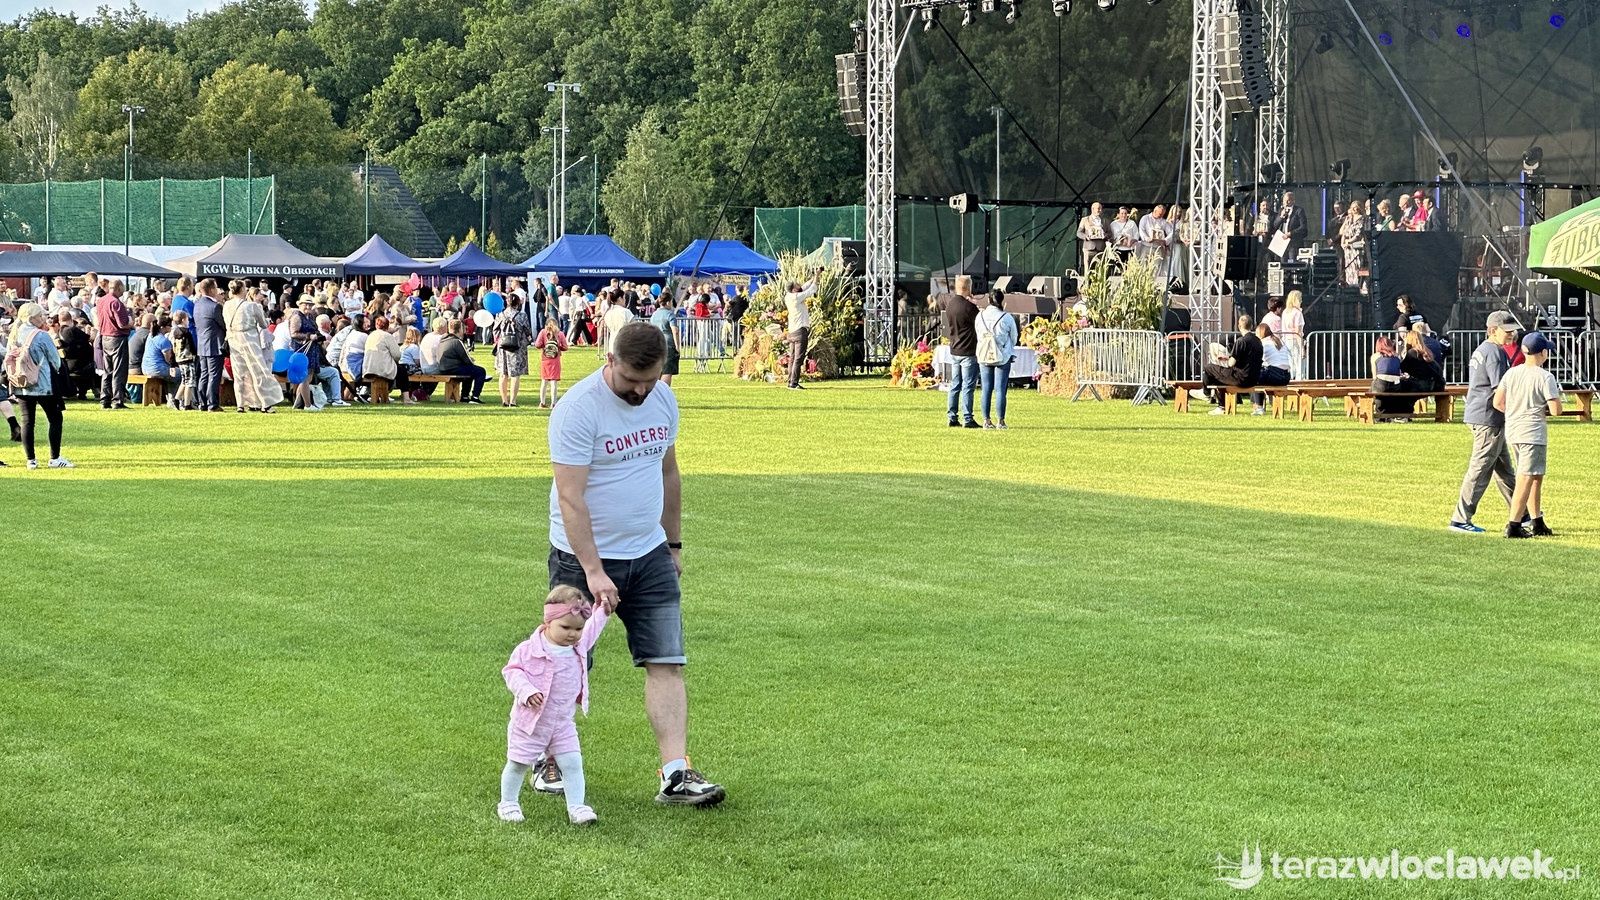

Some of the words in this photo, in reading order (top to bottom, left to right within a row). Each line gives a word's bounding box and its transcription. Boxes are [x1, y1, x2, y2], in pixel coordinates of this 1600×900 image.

[203, 264, 229, 274] KGW
[232, 264, 264, 274] BABKI
[266, 267, 280, 275] NA
[282, 266, 336, 275] OBROTACH
[643, 446, 663, 456] STAR
